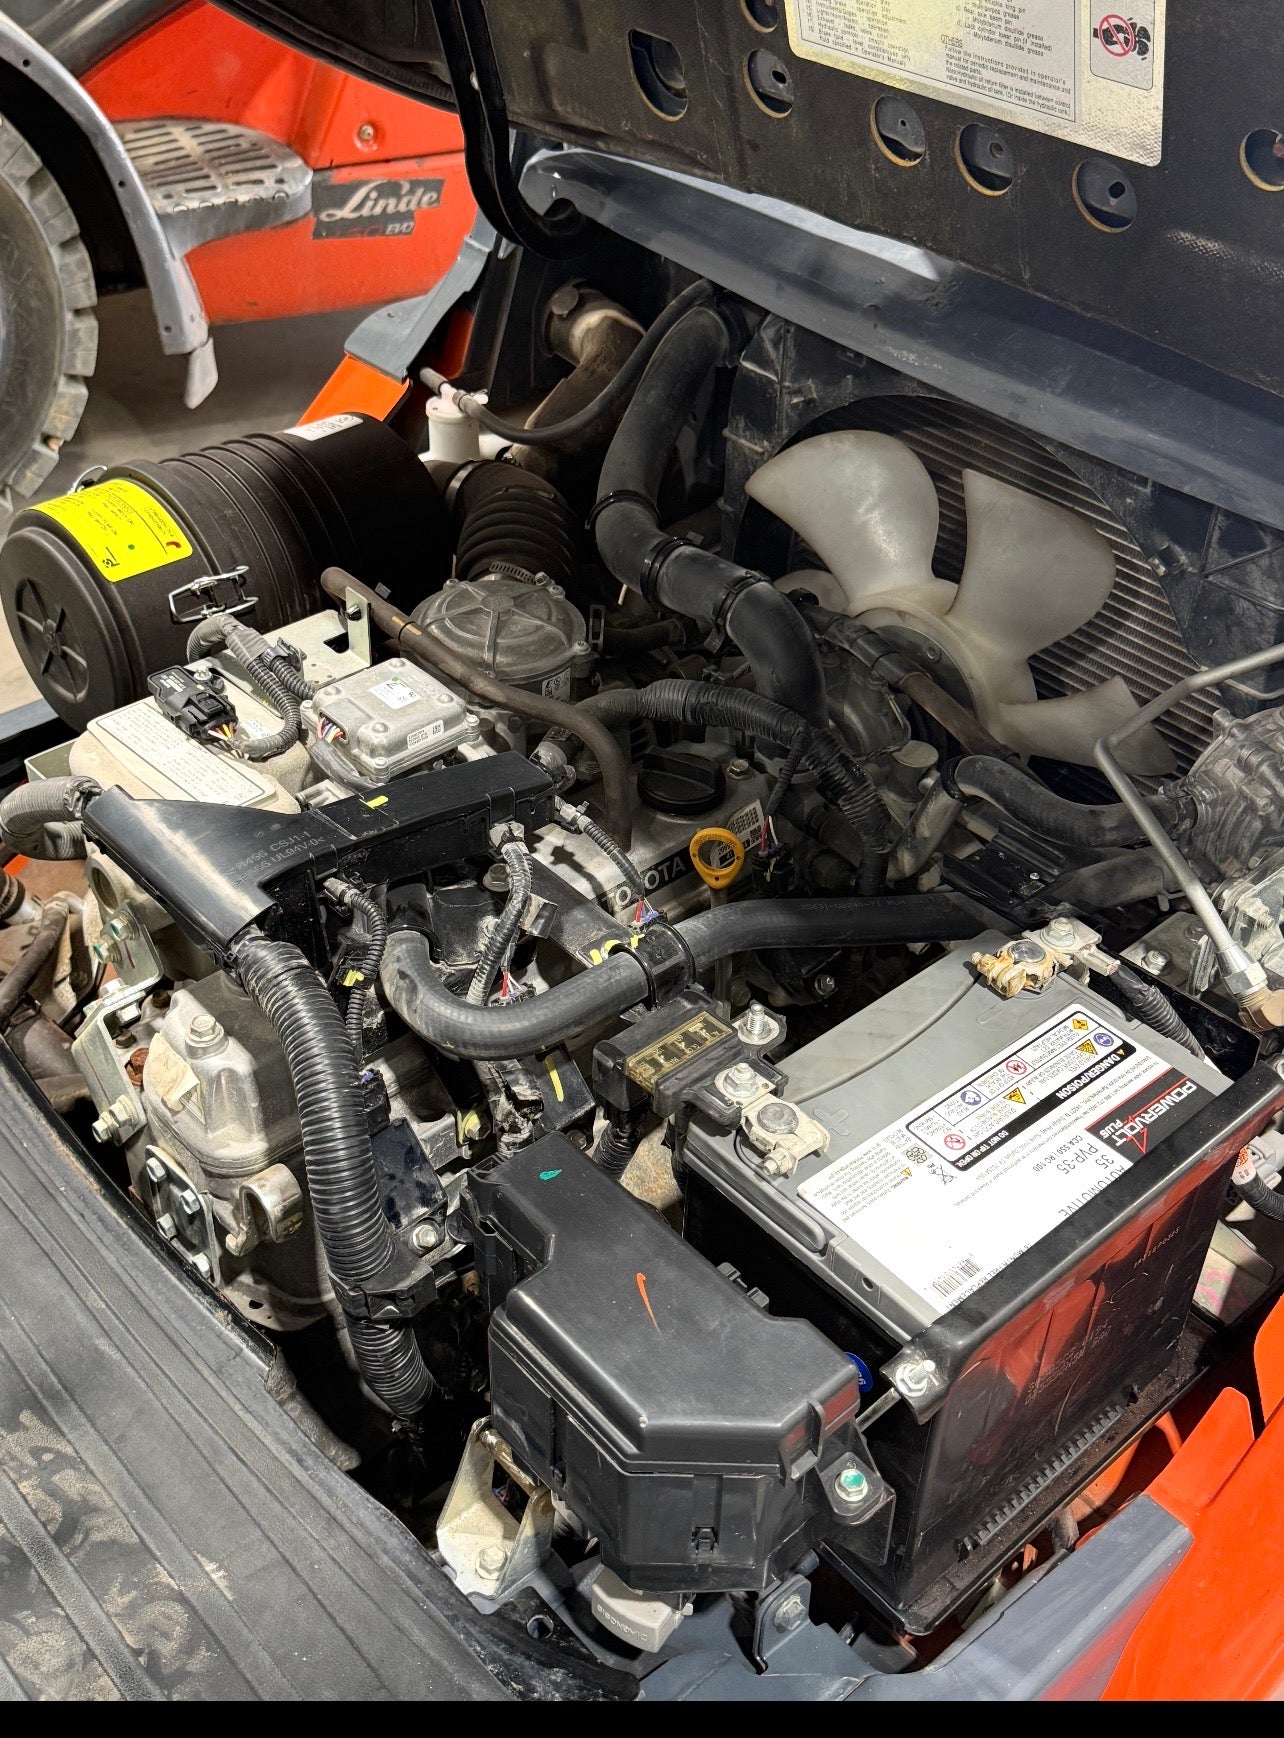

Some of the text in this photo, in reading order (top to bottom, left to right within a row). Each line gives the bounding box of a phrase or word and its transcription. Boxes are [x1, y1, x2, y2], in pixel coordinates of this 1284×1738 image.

[319, 180, 439, 222] Linde
[1054, 1053, 1120, 1099] DANGER/POISON
[1107, 1082, 1197, 1144] POWERVOLT
[997, 1129, 1009, 1138] DO
[1097, 1119, 1125, 1137] PLUS
[986, 1134, 1002, 1146] NOT
[1066, 1134, 1084, 1146] CCA
[969, 1148, 982, 1157] OR
[976, 1143, 991, 1152] TIP
[1054, 1143, 1071, 1155] 550
[1054, 1142, 1099, 1174] PVP-35
[1092, 1153, 1116, 1169] 35
[1031, 1161, 1047, 1172] 100
[1058, 1166, 1128, 1215] AUTOMOTIVE
